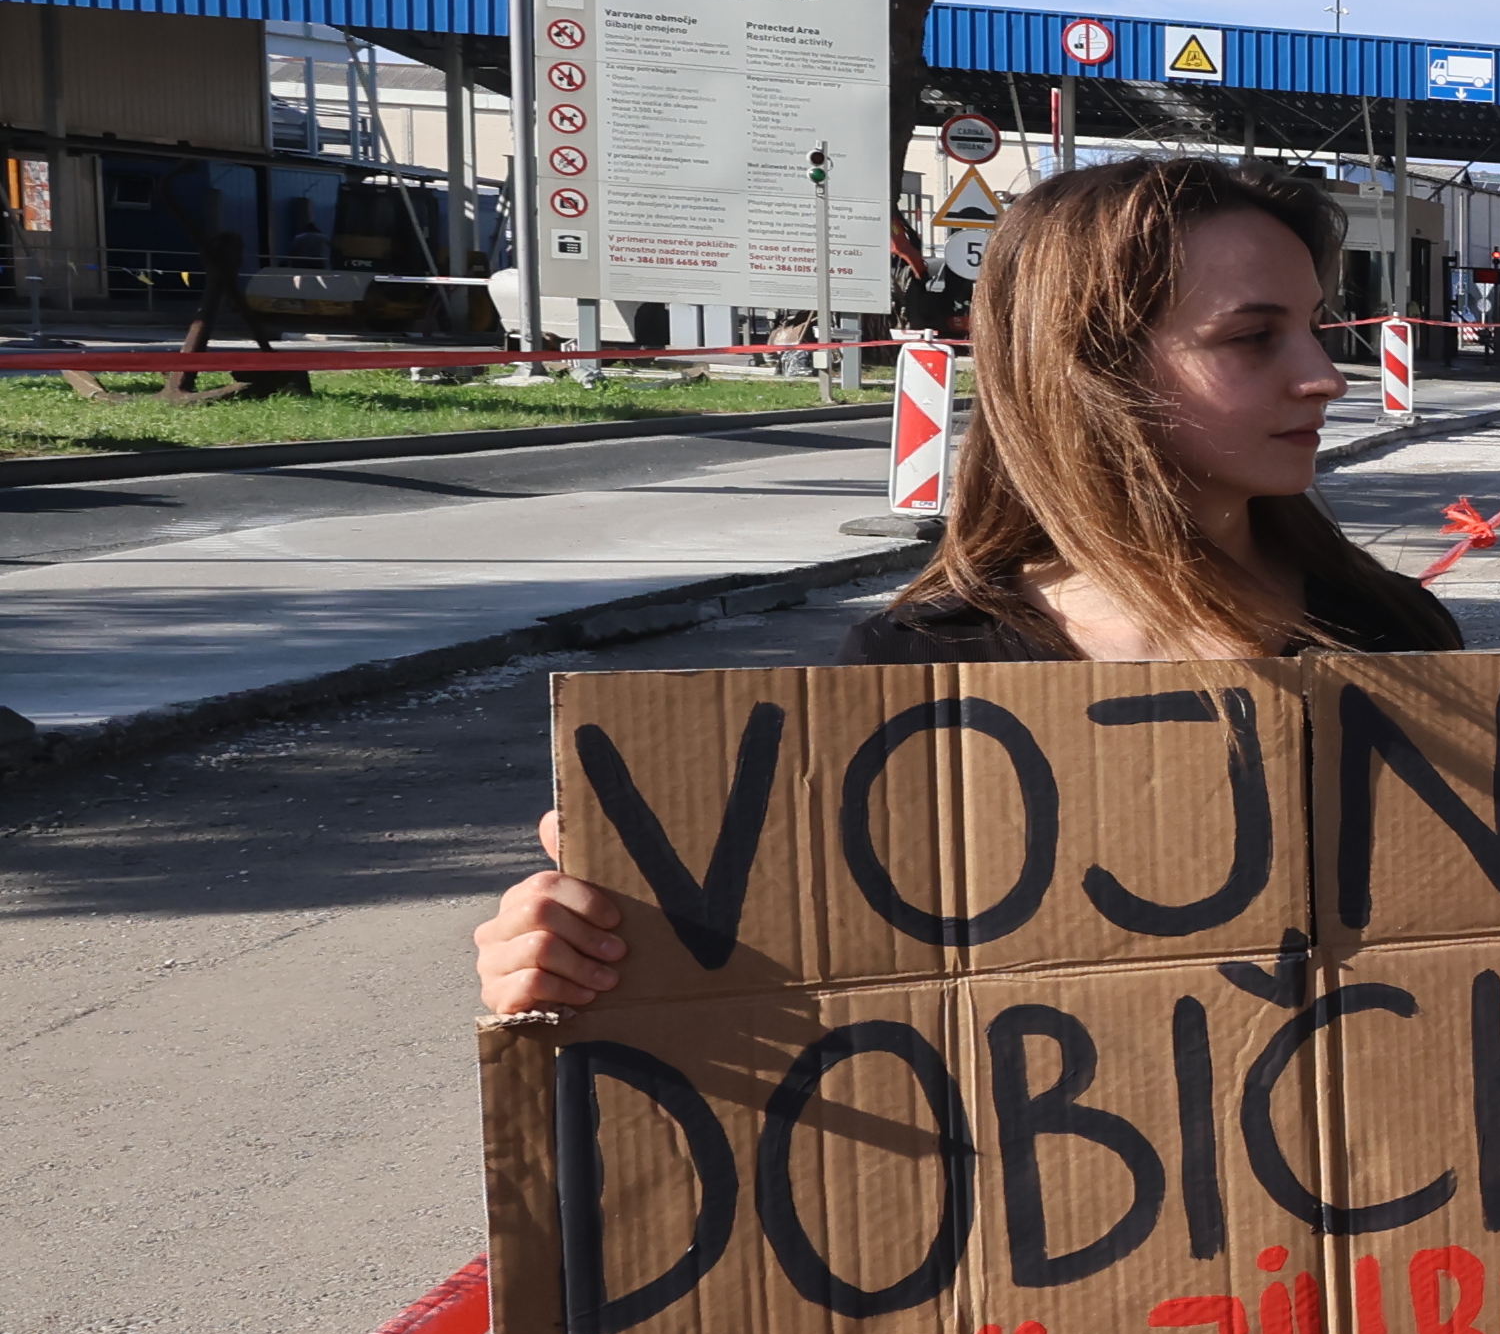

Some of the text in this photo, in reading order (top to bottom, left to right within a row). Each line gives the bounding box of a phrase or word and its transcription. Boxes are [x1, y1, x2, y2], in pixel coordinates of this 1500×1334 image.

[605, 9, 698, 25] Varovano območje
[605, 20, 688, 35] Gibanje omejeno
[746, 22, 820, 35] Protected Area
[746, 32, 833, 48] Restricted activity
[957, 127, 985, 136] CARINA
[616, 235, 655, 243] primeru
[609, 245, 656, 254] Varnostno
[658, 247, 699, 256] nadzorni
[967, 242, 982, 267] 5
[749, 253, 786, 263] Security
